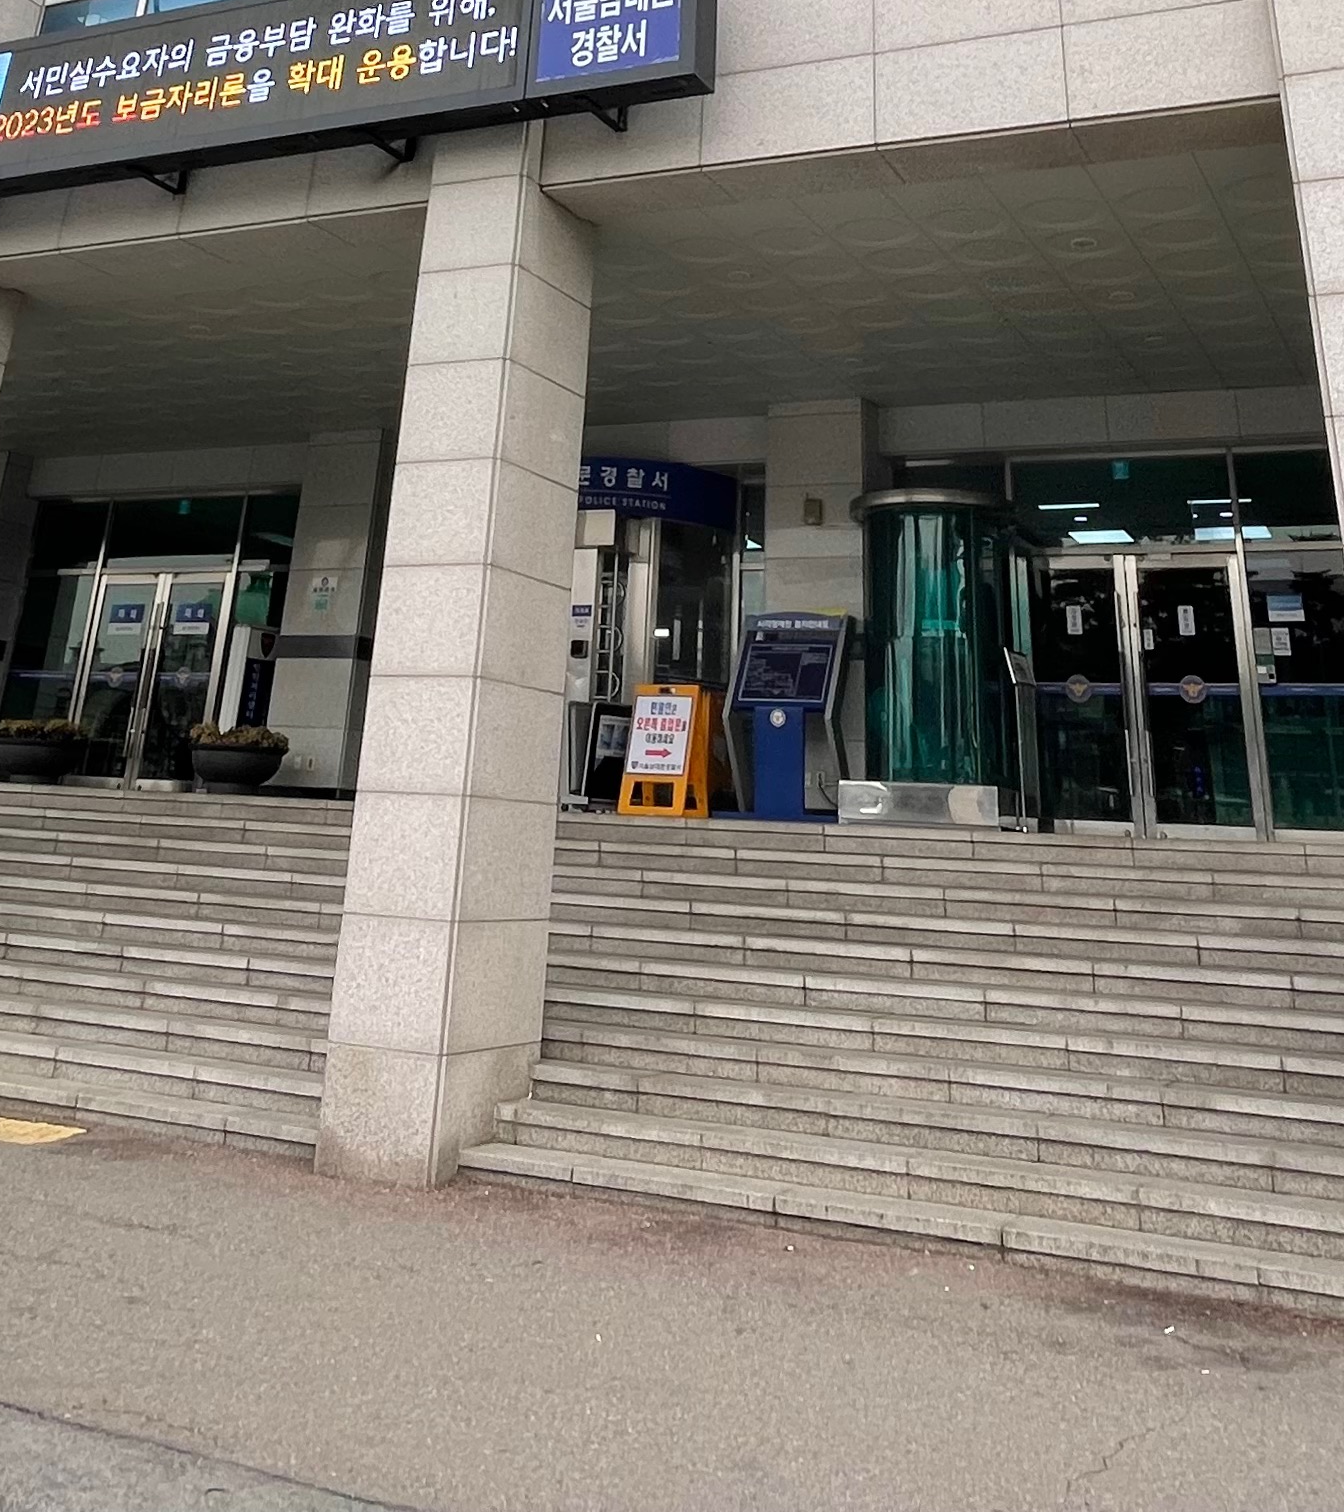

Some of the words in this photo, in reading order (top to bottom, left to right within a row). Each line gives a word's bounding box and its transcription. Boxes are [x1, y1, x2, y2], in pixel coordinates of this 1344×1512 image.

[19, 38, 194, 99] 서민실수요자의
[205, 16, 317, 67] 금융부담
[327, 0, 416, 46] 완화를
[111, 68, 276, 123] 보금자리론을
[287, 54, 346, 95] 확대
[356, 26, 519, 85] 운용합니다!
[570, 18, 647, 67] 경찰서
[622, 497, 667, 511] STATION
